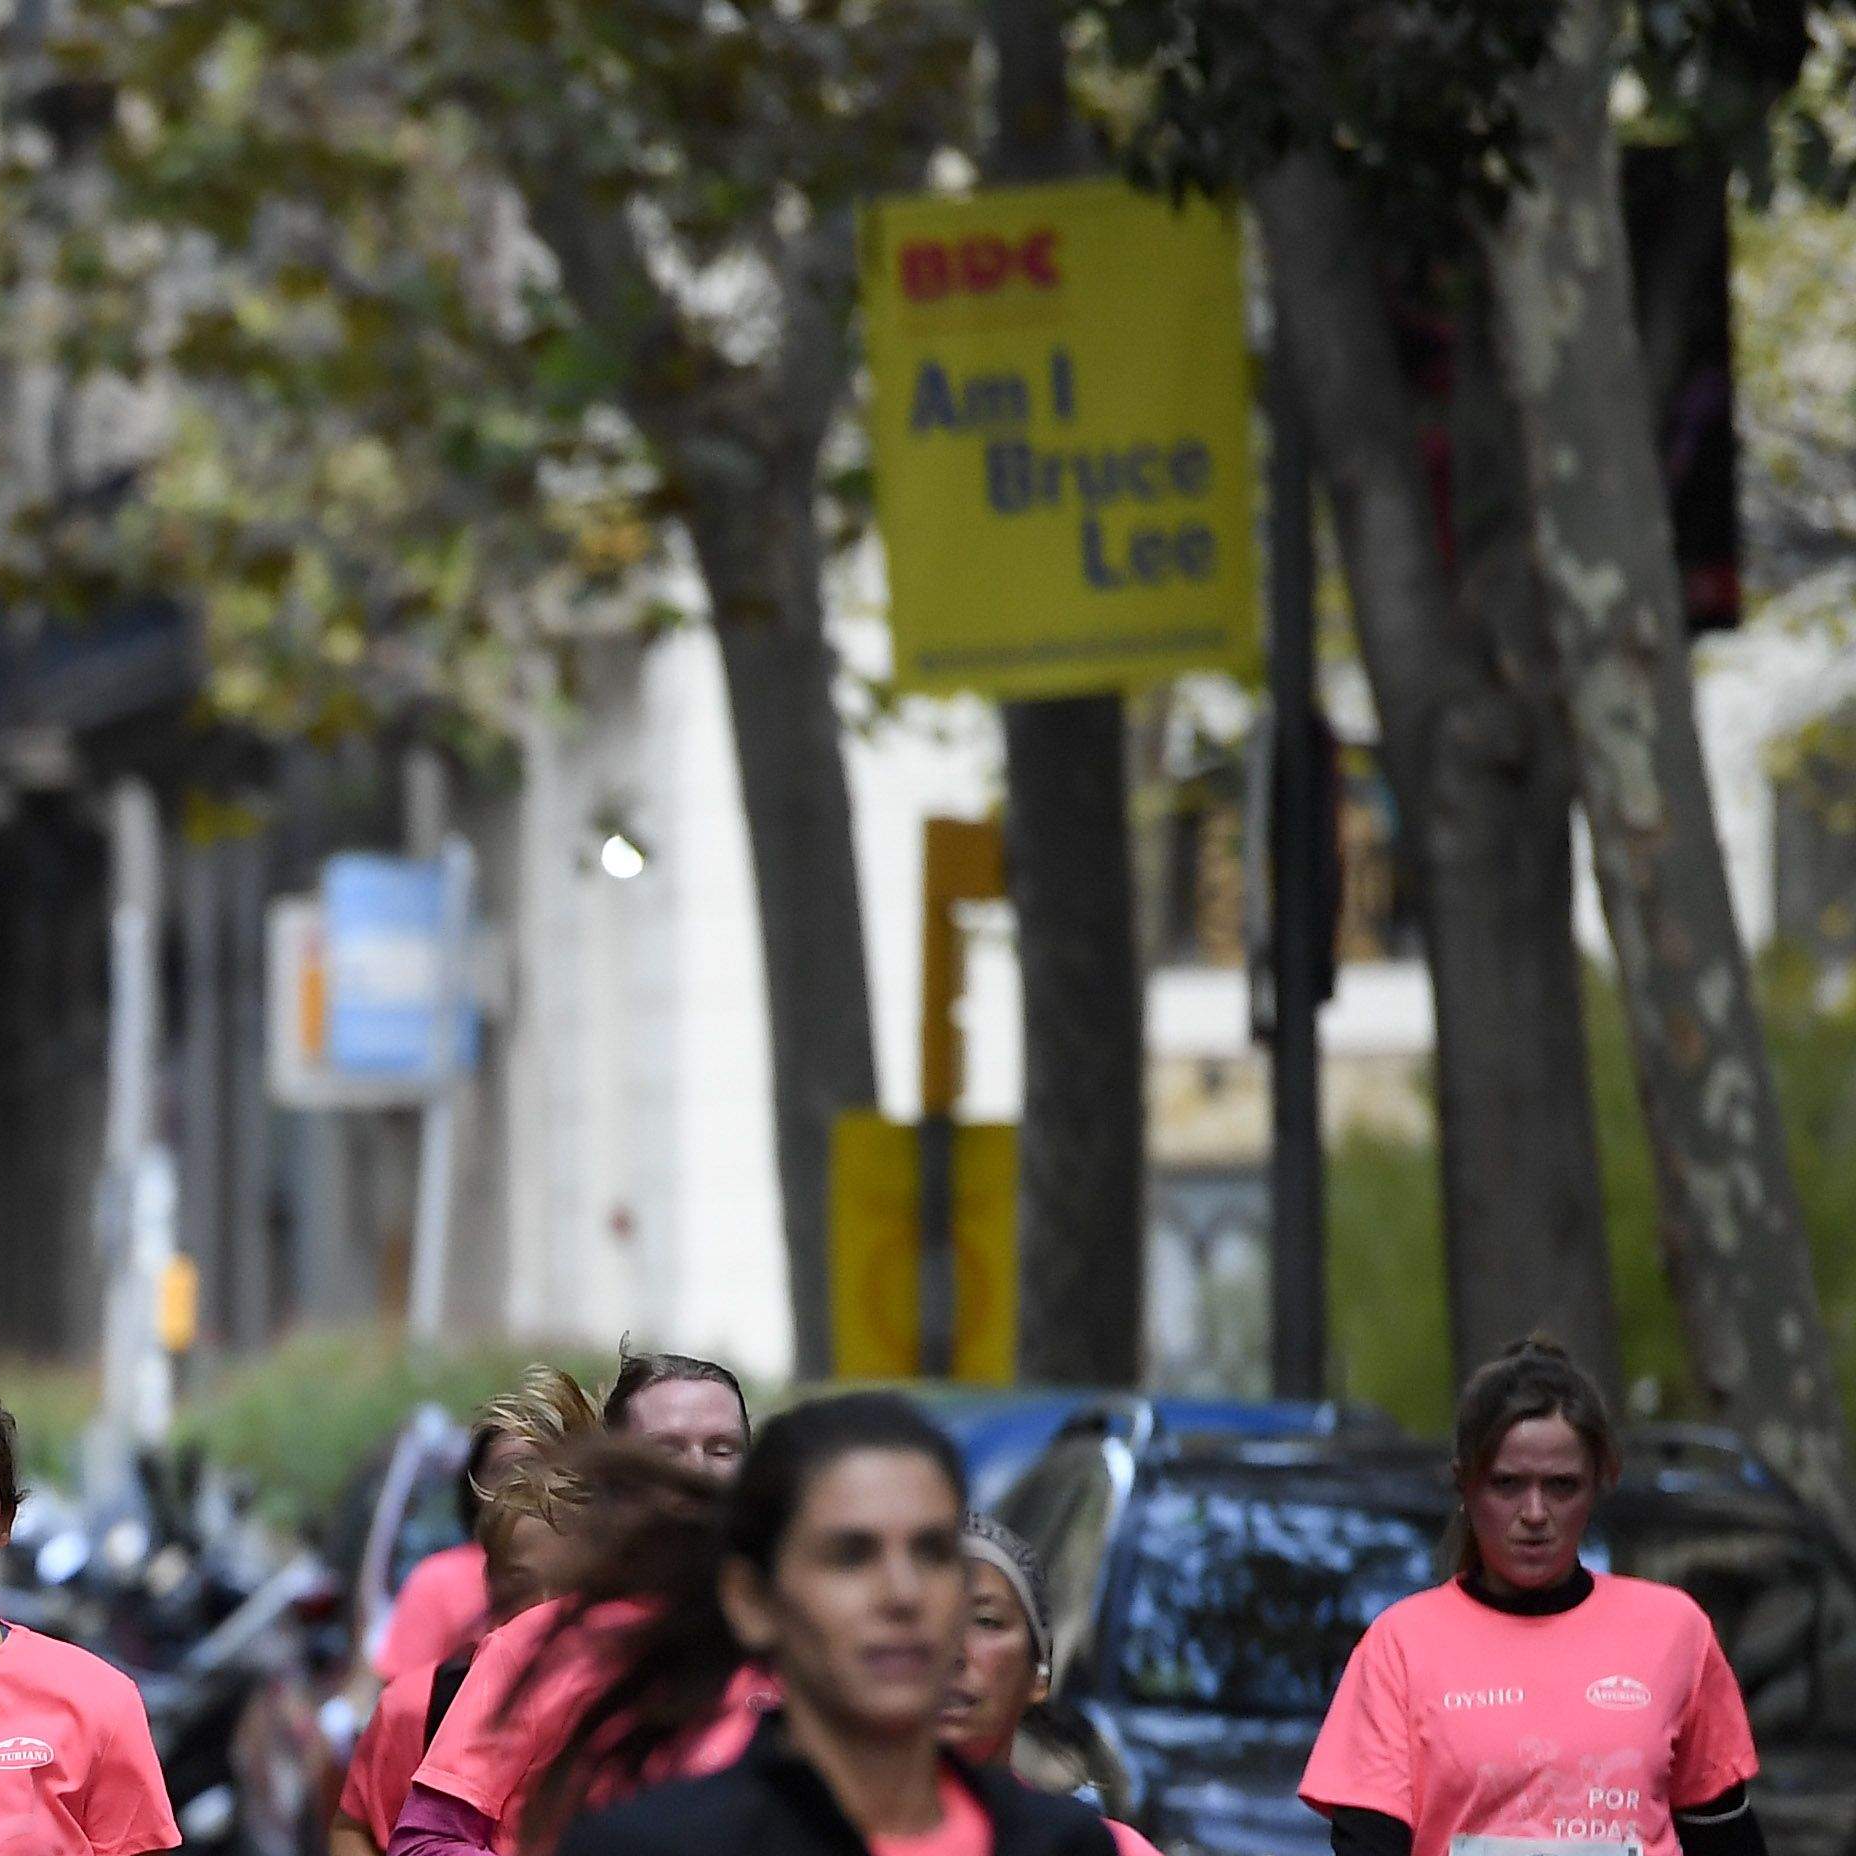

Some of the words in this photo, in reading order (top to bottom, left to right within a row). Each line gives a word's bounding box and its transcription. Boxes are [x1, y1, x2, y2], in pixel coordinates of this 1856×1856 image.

[910, 360, 1030, 436] Am
[1050, 344, 1074, 423] I
[984, 440, 1211, 514] Bruce
[1081, 518, 1216, 589] Lee
[1443, 1687, 1525, 1709] OYSHO
[1589, 1787, 1640, 1811] POR
[1553, 1817, 1637, 1841] TODAS
